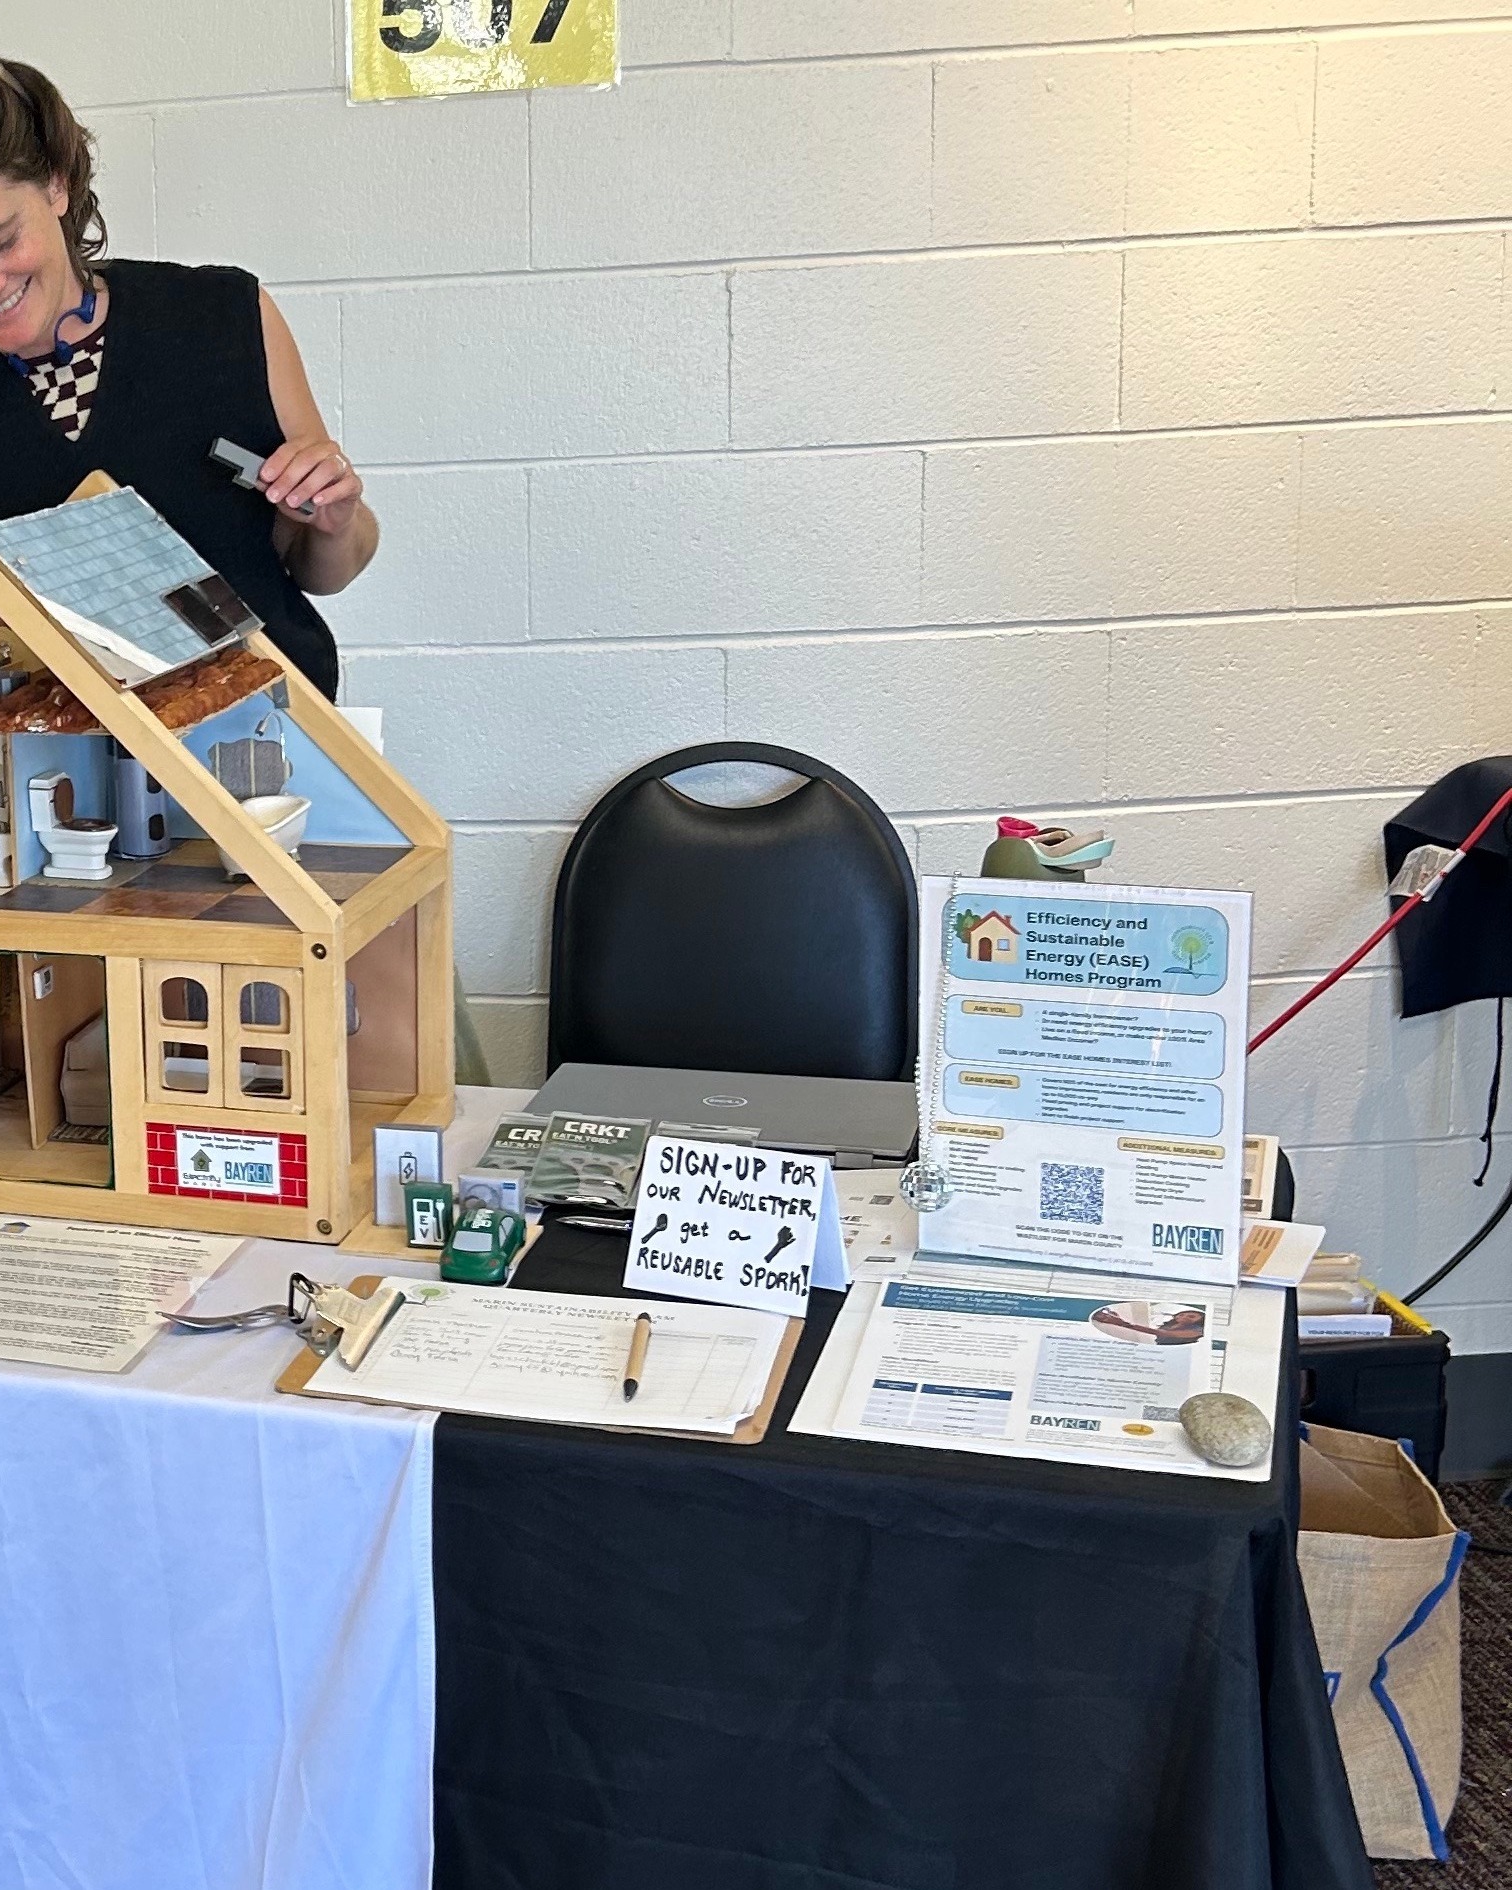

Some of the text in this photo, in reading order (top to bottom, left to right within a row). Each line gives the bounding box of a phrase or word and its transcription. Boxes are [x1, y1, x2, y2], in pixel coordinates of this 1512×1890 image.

[1026, 911, 1149, 931] Efficiency and
[1025, 930, 1126, 949] Sustainable
[1025, 950, 1150, 972] Energy (EASE)
[1025, 968, 1162, 990] Homes Program
[508, 1128, 542, 1141] CR
[563, 1120, 632, 1139] CRKT
[224, 1161, 273, 1185] BAYREN
[659, 1145, 817, 1188] SIGN-UP FOR
[646, 1183, 681, 1202] OUR
[418, 1214, 430, 1239] EV
[680, 1221, 751, 1243] get a
[1152, 1223, 1224, 1255] BAYREN
[636, 1246, 725, 1281] REUSABLE
[1030, 1415, 1101, 1432] BAYREN
